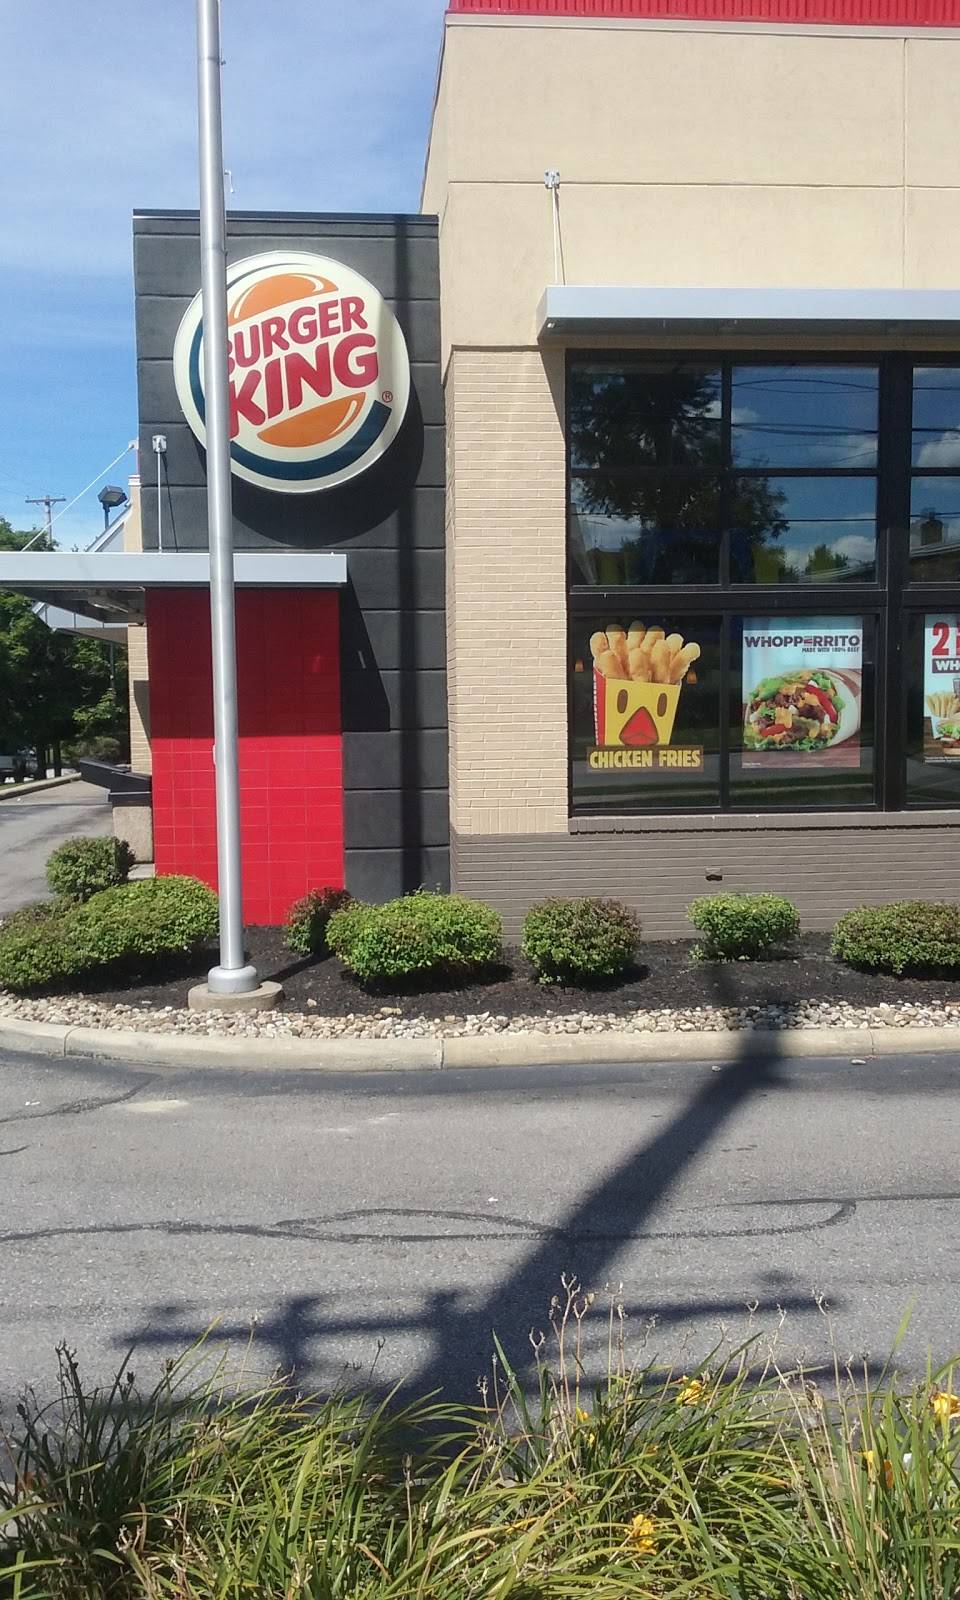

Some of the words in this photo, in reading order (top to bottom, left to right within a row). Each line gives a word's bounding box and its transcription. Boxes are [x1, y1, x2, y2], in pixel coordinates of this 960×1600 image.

[228, 333, 379, 439] KING
[744, 635, 860, 648] WHOPPERRITO
[933, 622, 949, 656] 2
[589, 750, 653, 769] CHICKEN
[659, 749, 701, 768] FRIES
